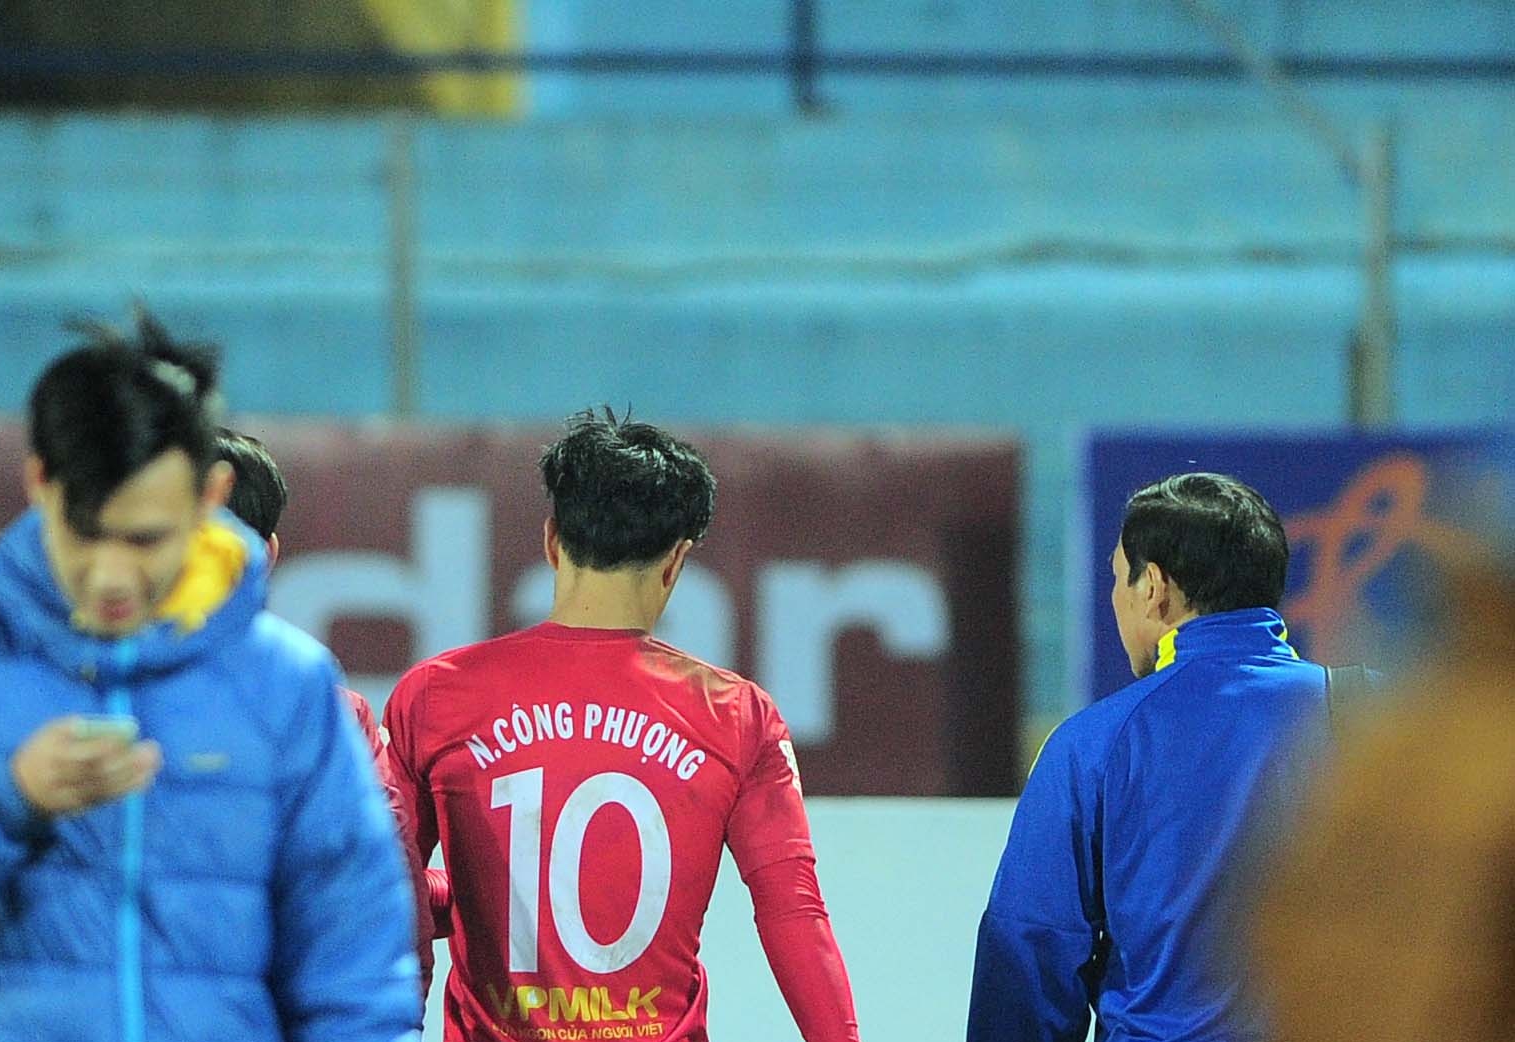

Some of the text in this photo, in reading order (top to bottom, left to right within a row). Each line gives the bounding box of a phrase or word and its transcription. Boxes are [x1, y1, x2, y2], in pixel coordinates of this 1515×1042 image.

[584, 704, 707, 782] PHƯỢNG
[490, 766, 672, 974] 10
[486, 984, 662, 1021] VPMILK
[557, 1024, 588, 1040] CỦA
[636, 1021, 665, 1039] VIỆT
